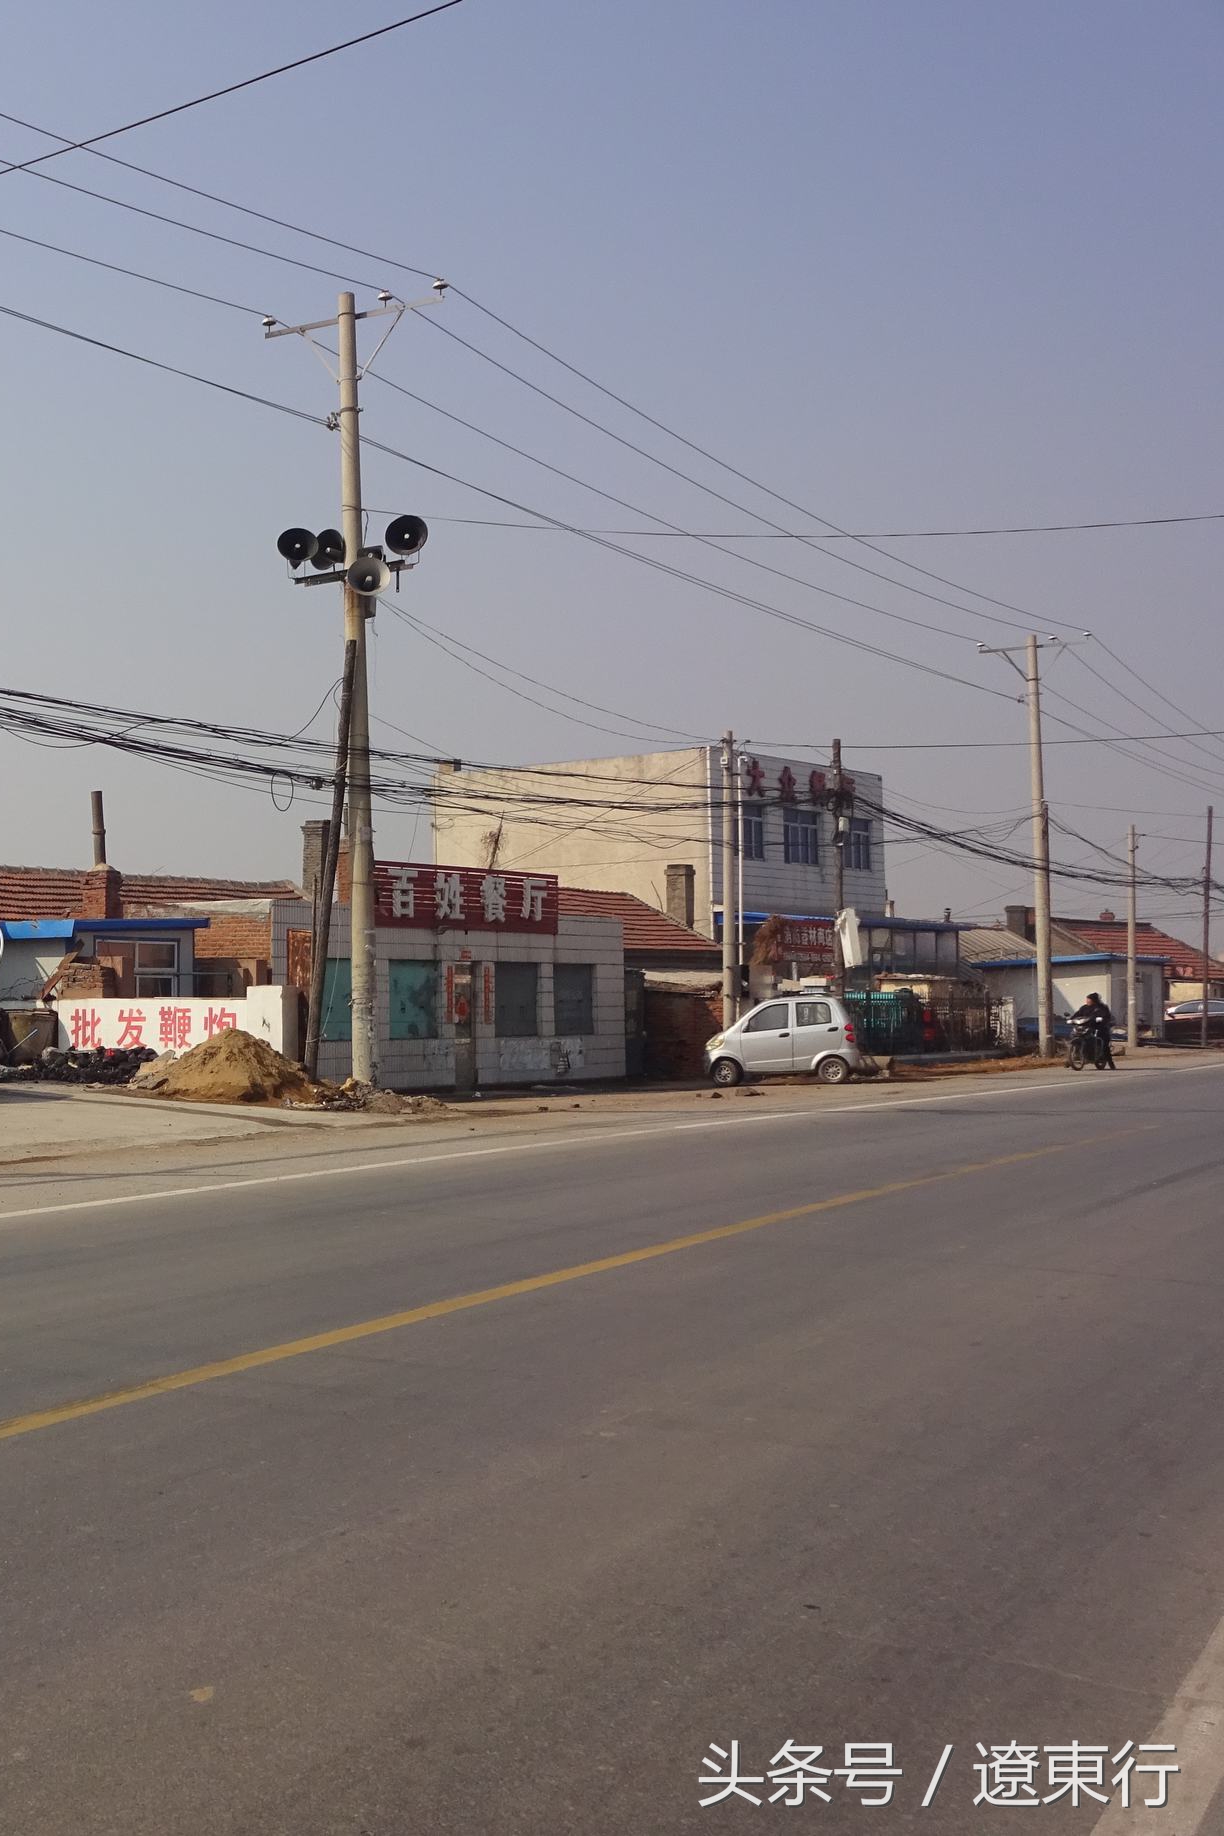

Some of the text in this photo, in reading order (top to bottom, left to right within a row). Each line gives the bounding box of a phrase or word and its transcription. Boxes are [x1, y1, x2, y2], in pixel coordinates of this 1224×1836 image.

[387, 868, 548, 923] 百姓餐厅
[70, 1006, 238, 1048] 批发鞭炮
